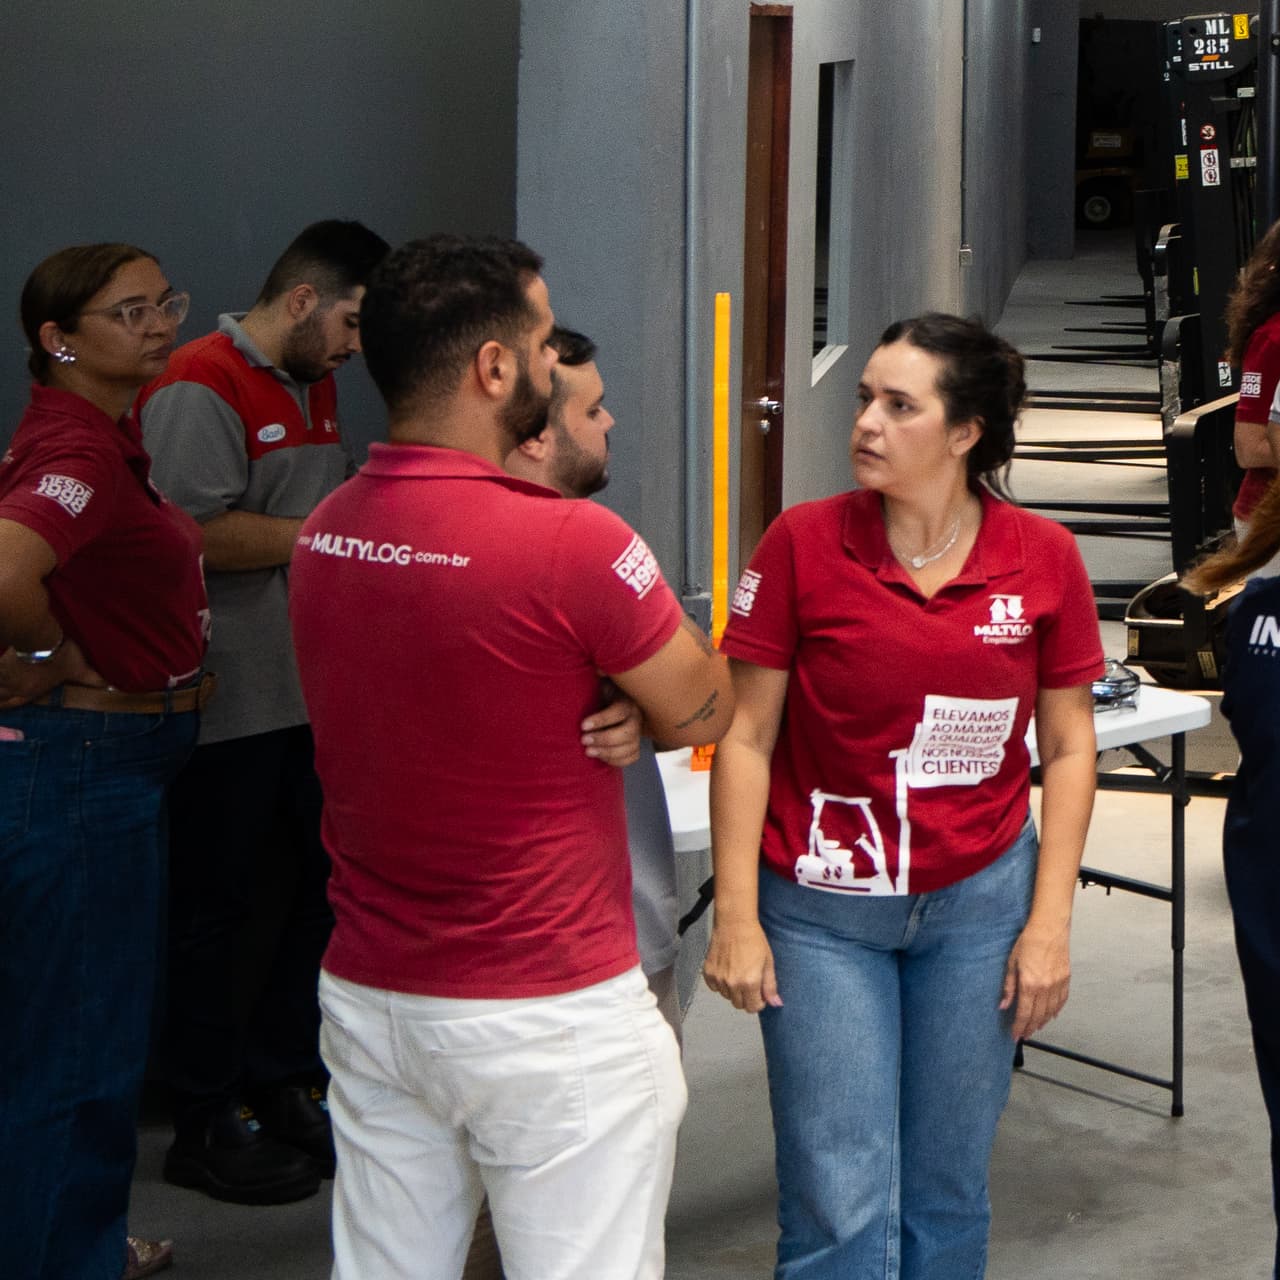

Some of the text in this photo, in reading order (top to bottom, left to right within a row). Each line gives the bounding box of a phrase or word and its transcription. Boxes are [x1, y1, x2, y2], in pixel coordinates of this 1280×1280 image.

[1205, 19, 1230, 35] ML
[1193, 38, 1230, 55] 285
[1188, 60, 1235, 71] STILL
[974, 624, 1033, 637] MULTYLO
[932, 708, 1011, 723] ELEVAMOS
[931, 723, 1008, 734] AO MÁXIMO
[922, 760, 999, 775] CLIENTES
